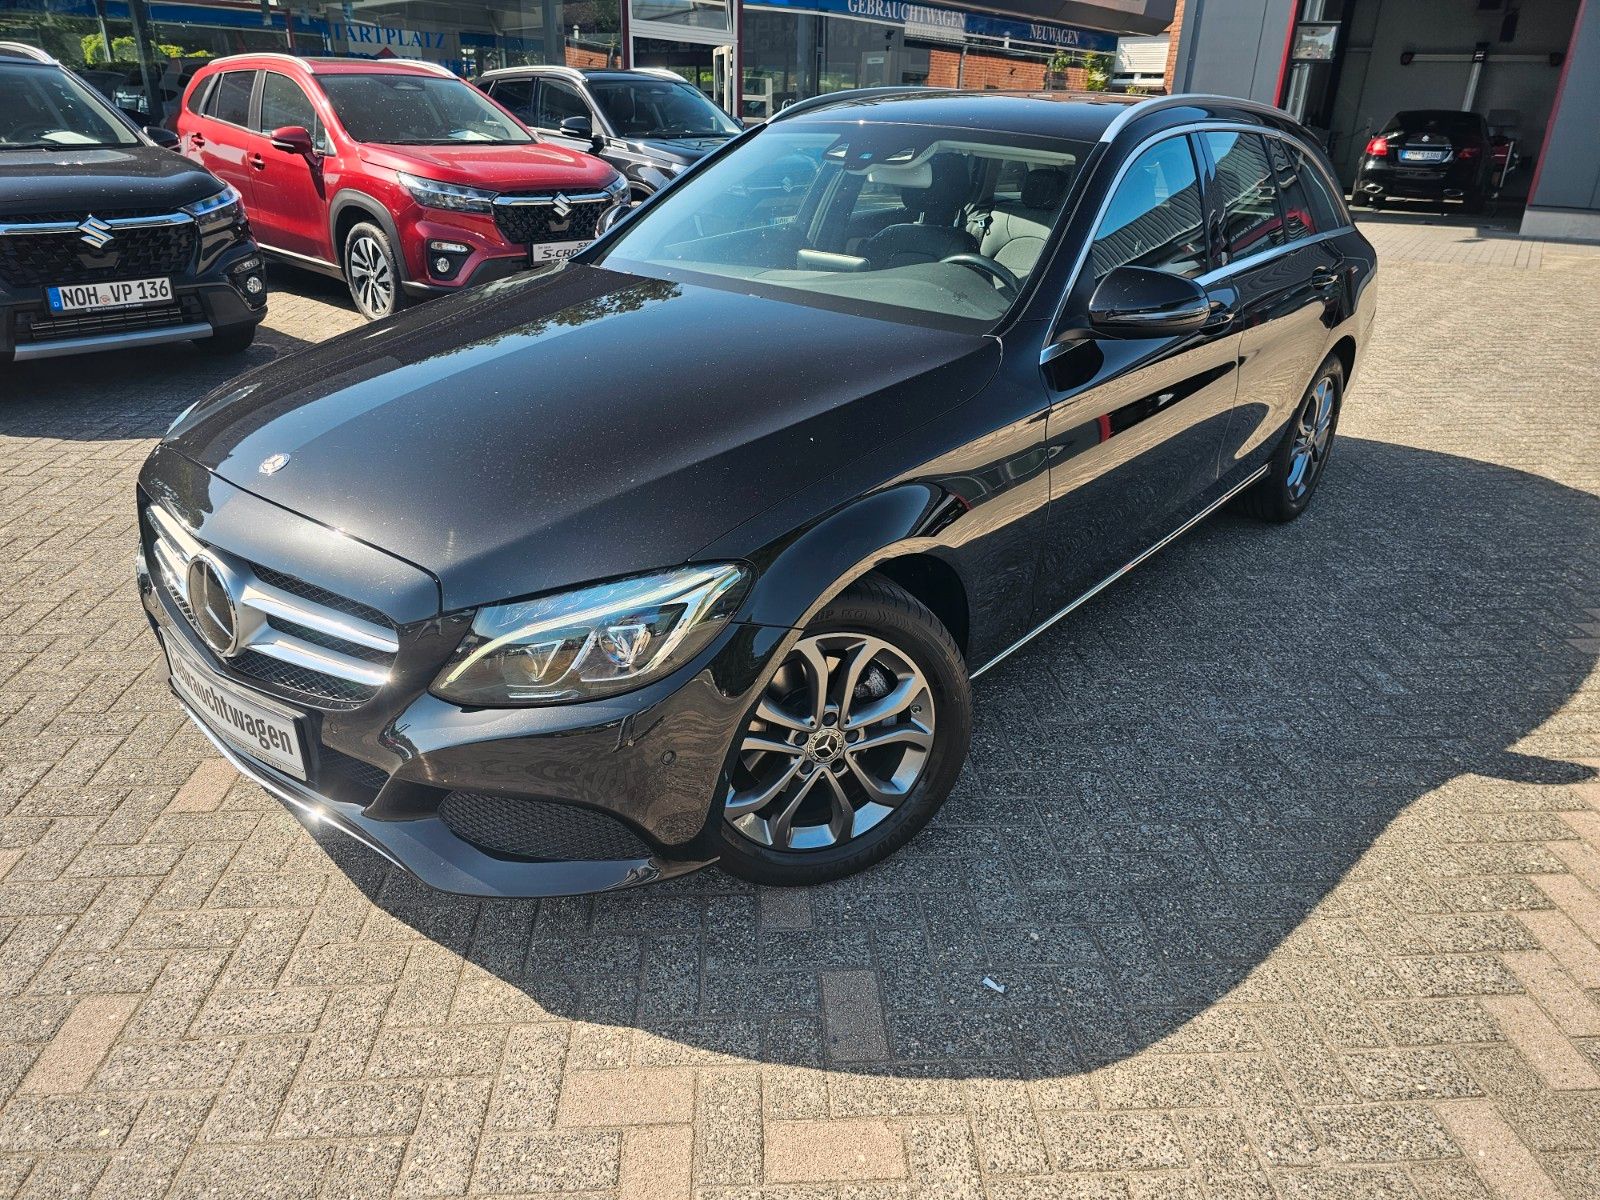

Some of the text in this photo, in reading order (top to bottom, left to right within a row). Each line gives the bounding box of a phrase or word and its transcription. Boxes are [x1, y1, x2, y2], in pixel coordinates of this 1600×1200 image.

[848, 0, 967, 28] GEBRAUCHTWAGEN
[323, 22, 446, 49] TARTPLATZ
[1029, 23, 1080, 44] NEUWAGEN
[61, 280, 169, 307] NOH VP 136
